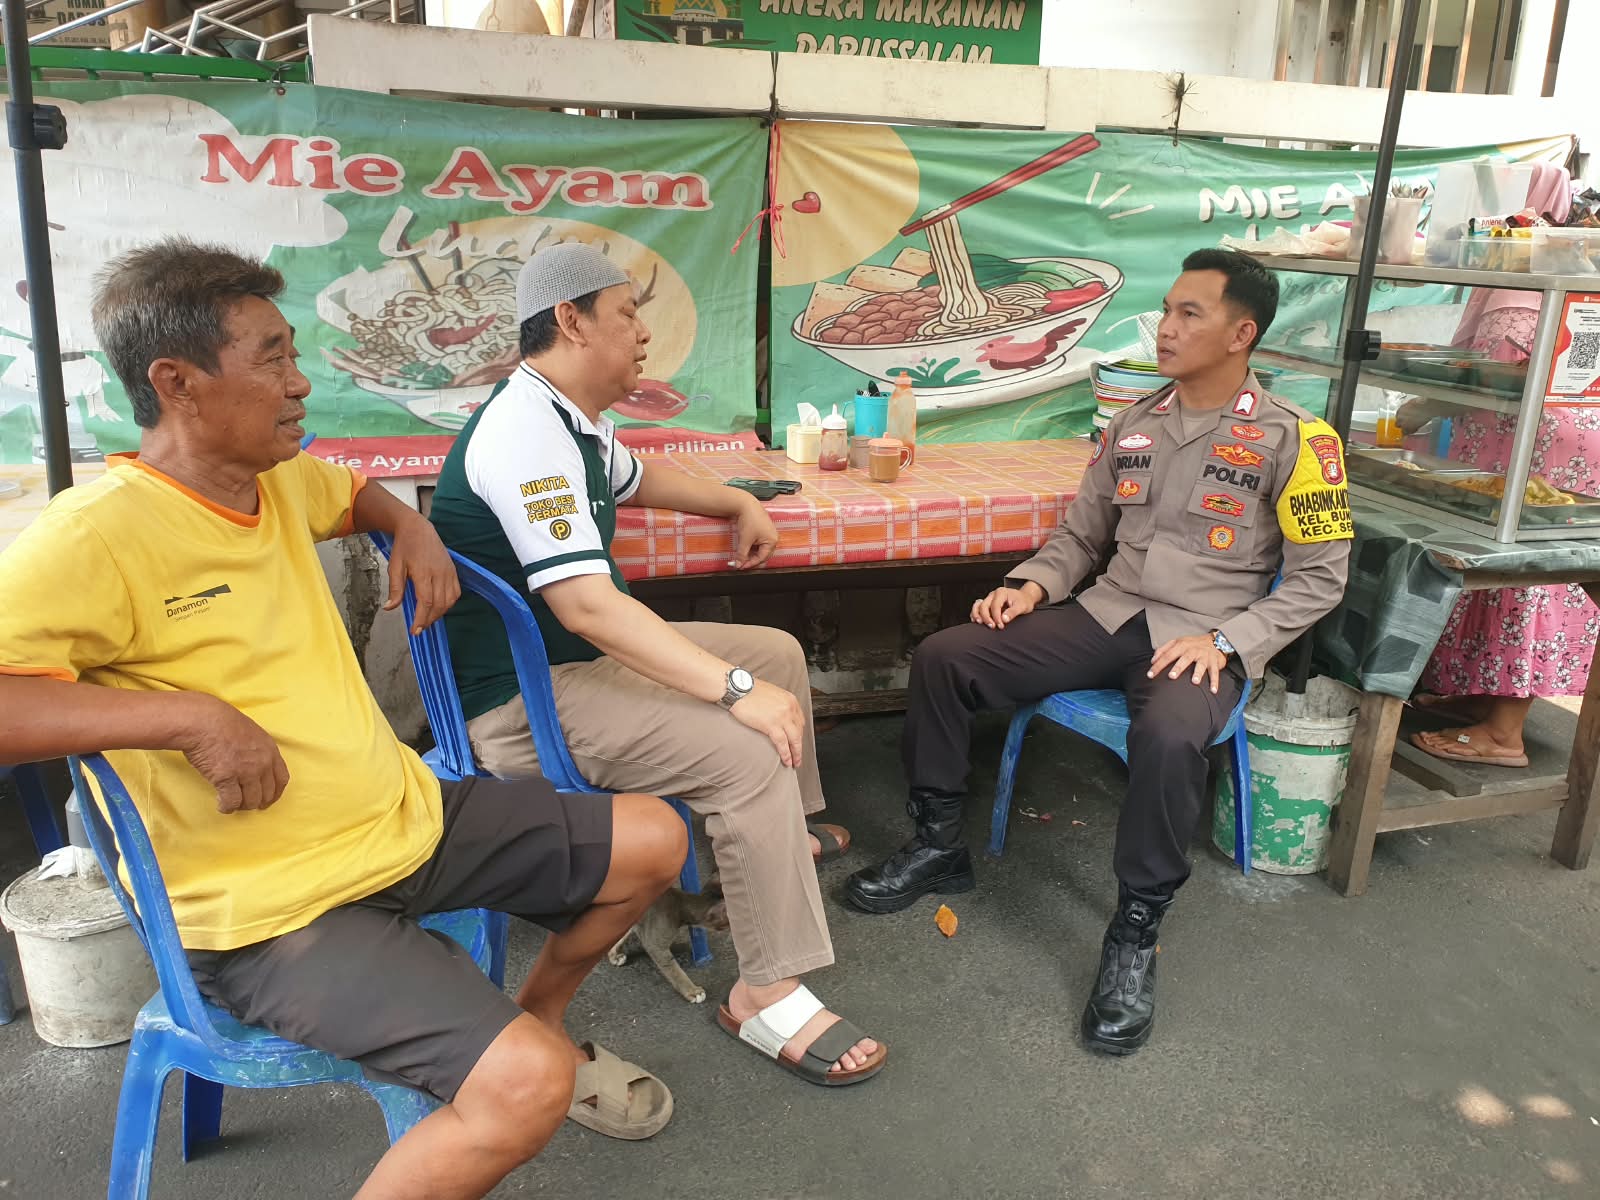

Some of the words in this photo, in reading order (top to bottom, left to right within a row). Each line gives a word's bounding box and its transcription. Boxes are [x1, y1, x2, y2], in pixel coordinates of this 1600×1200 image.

[875, 0, 1025, 31] MAKANAN
[198, 133, 400, 193] Mie
[427, 148, 710, 212] Ayam
[1199, 184, 1301, 222] MIE
[370, 454, 447, 471] Ayam
[663, 439, 745, 454] Pilihan
[520, 476, 570, 497] NIKITA
[1203, 464, 1261, 491] POLRI
[524, 498, 553, 513] TOKO
[554, 494, 576, 506] BESI
[527, 504, 579, 523] PERMATA
[1297, 513, 1330, 527] KEL.
[1301, 524, 1338, 538] KEC.
[166, 598, 209, 618] Danamon
